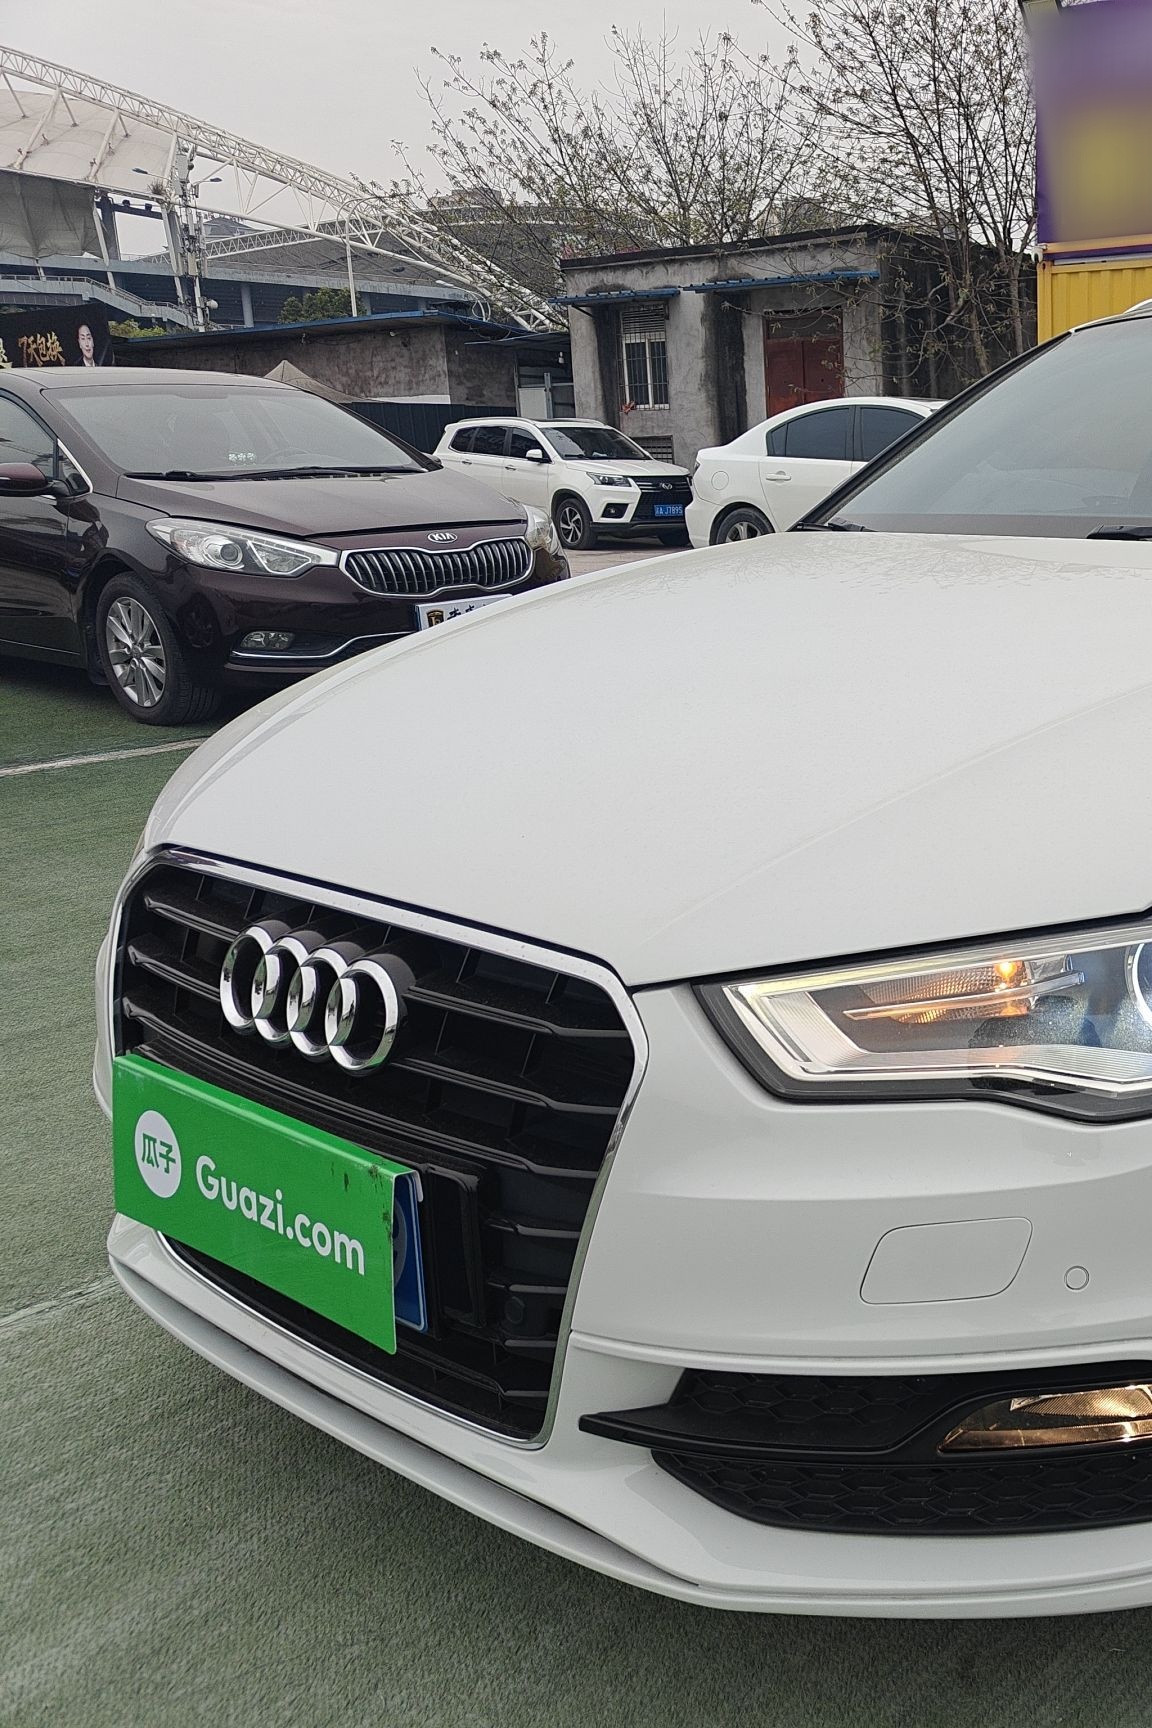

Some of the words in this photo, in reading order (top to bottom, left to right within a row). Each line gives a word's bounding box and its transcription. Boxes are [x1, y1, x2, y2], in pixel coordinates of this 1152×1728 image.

[430, 531, 456, 542] KIA
[141, 1133, 177, 1175] 瓜子
[195, 1155, 365, 1276] Guazi.com
